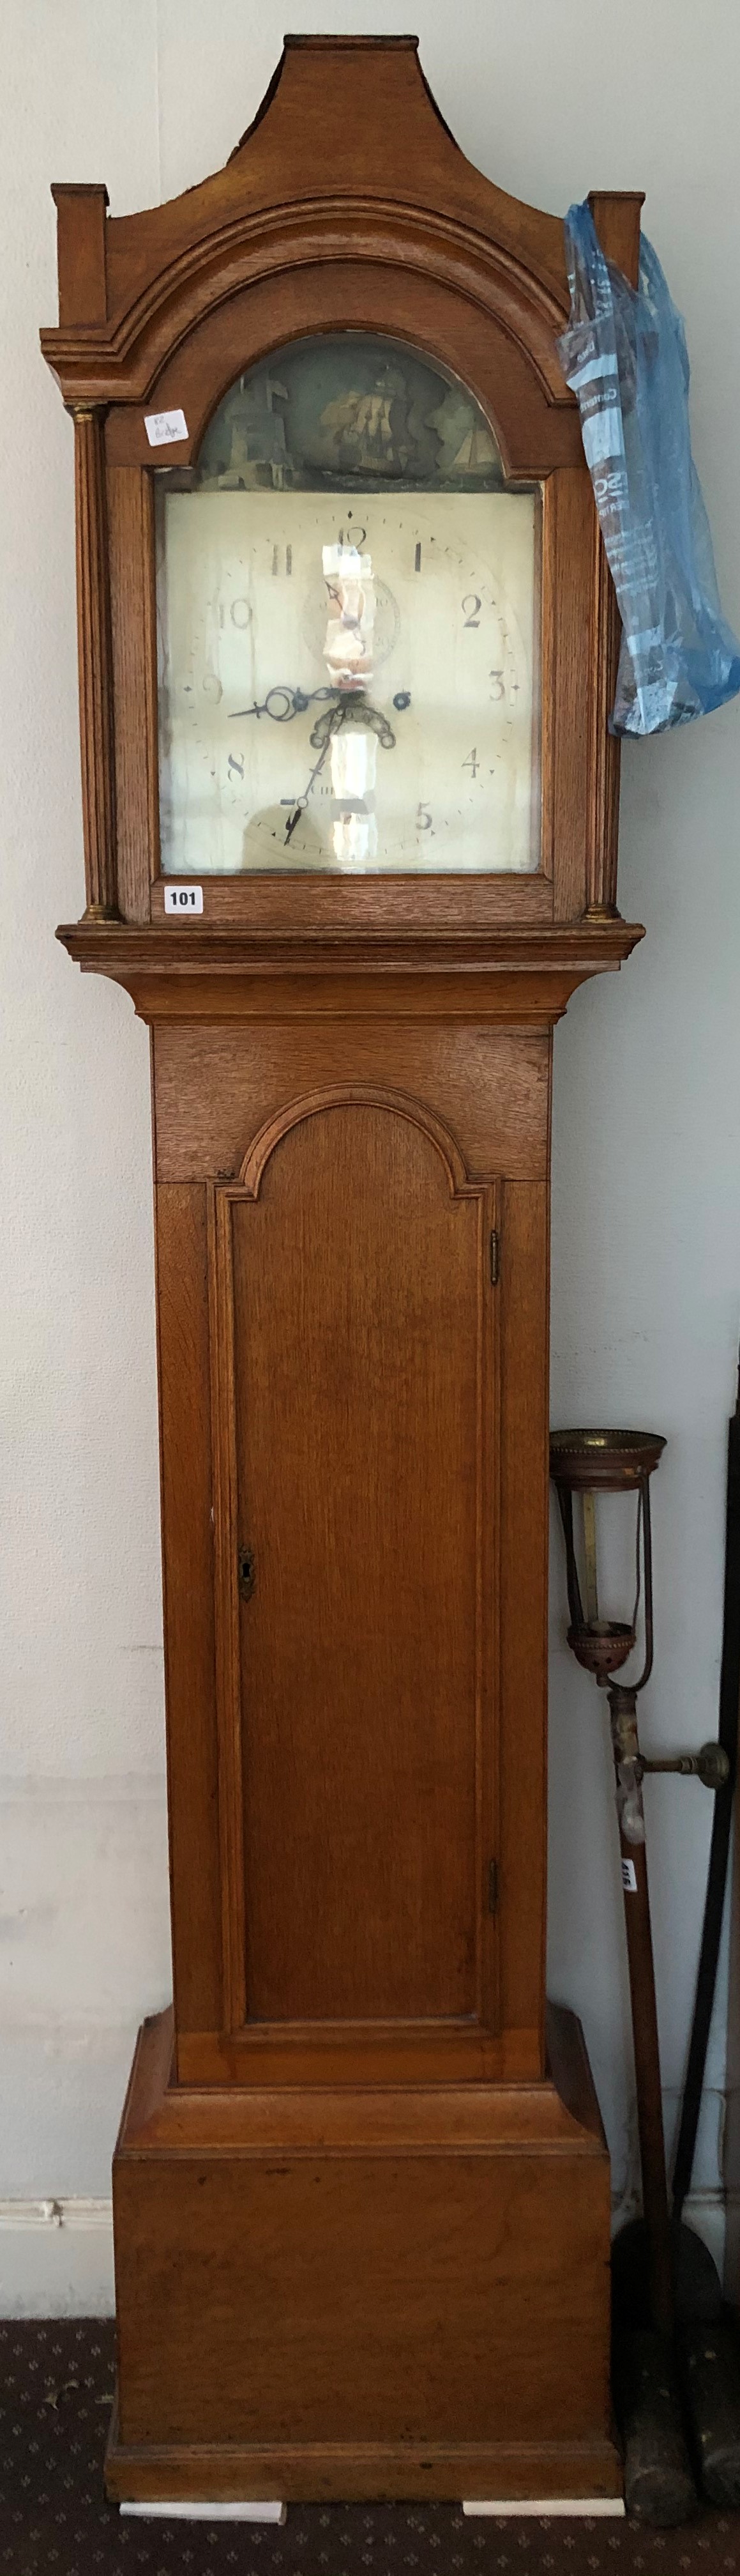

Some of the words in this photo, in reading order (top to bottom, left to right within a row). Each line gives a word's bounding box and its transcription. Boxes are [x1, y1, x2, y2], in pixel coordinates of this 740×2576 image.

[272, 544, 292, 575] 11
[415, 542, 421, 572] 1
[219, 598, 252, 629] 10
[462, 594, 481, 628] 2
[202, 673, 223, 705] 9
[489, 670, 506, 700] 3
[227, 753, 245, 782] 8
[461, 747, 479, 778] 4
[415, 802, 432, 830] 5
[170, 892, 195, 905] 101
